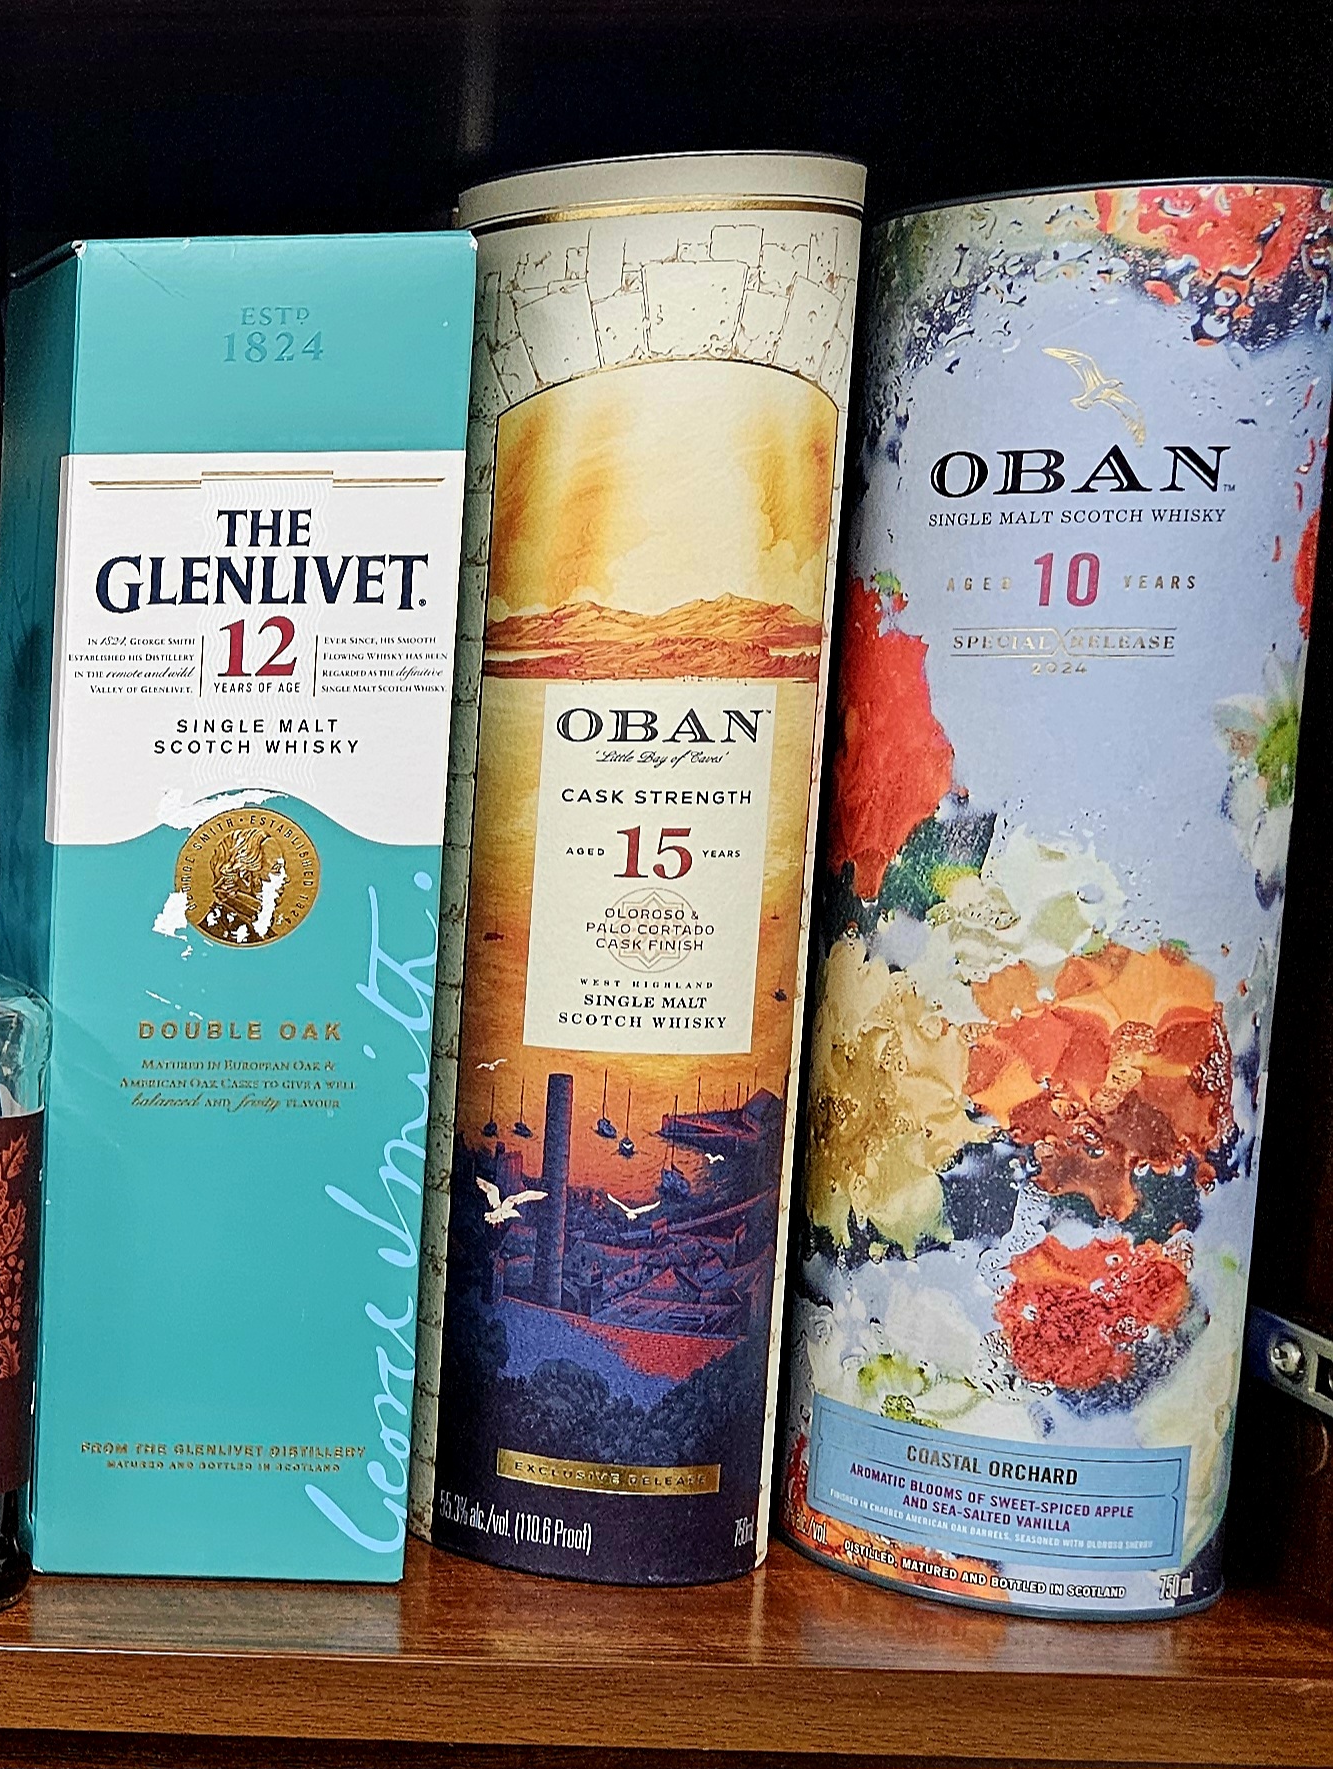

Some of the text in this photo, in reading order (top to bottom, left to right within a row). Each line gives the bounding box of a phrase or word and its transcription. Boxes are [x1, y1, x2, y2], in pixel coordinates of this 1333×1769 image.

[223, 331, 324, 363] 1824
[930, 444, 1231, 498] OBAN
[217, 508, 311, 547] THE
[929, 509, 1226, 527] SINGLE MALT SCOTCH WHISKY
[95, 553, 428, 614] GLENLIVET
[946, 552, 1196, 608] AGED 10 YEARS
[218, 615, 299, 677] 12
[953, 635, 1174, 650] SPECIAL RELEASE
[214, 682, 300, 694] YEARS OF AGE
[177, 719, 338, 734] SINGLE MALT
[556, 708, 765, 744] OBAN
[154, 739, 359, 755] SCOTCH WHISKY
[561, 788, 752, 805] CASK STRENGTH
[193, 815, 314, 887] SMITH ESTABLISHED
[566, 825, 741, 880] AGED 15 YEARS
[605, 907, 699, 920] OLOROSO &
[586, 922, 715, 936] PALO CORTADO
[596, 938, 704, 951] CASK FINISH
[580, 978, 713, 989] WEST HIGHLAND
[584, 993, 707, 1009] SINGLE MALT
[138, 1021, 341, 1040] DOUBLE OAK
[558, 1012, 727, 1029] SCOTCH WHISKY
[514, 1461, 620, 1485] EXCLUSIVE
[907, 1445, 1079, 1486] COASTAL ORCHARD
[850, 1463, 1134, 1519] AROMATIC BLOOMS OF SWEET-SPICED APPLE
[439, 1490, 592, 1556] 55.3% alc./vol. (110.6 Proof)
[903, 1495, 1070, 1533] AND SEA-SALTED VANILLA
[844, 1540, 1127, 1599] DISTILLED, MATURED AND BOTTLED IN SCOTLAND
